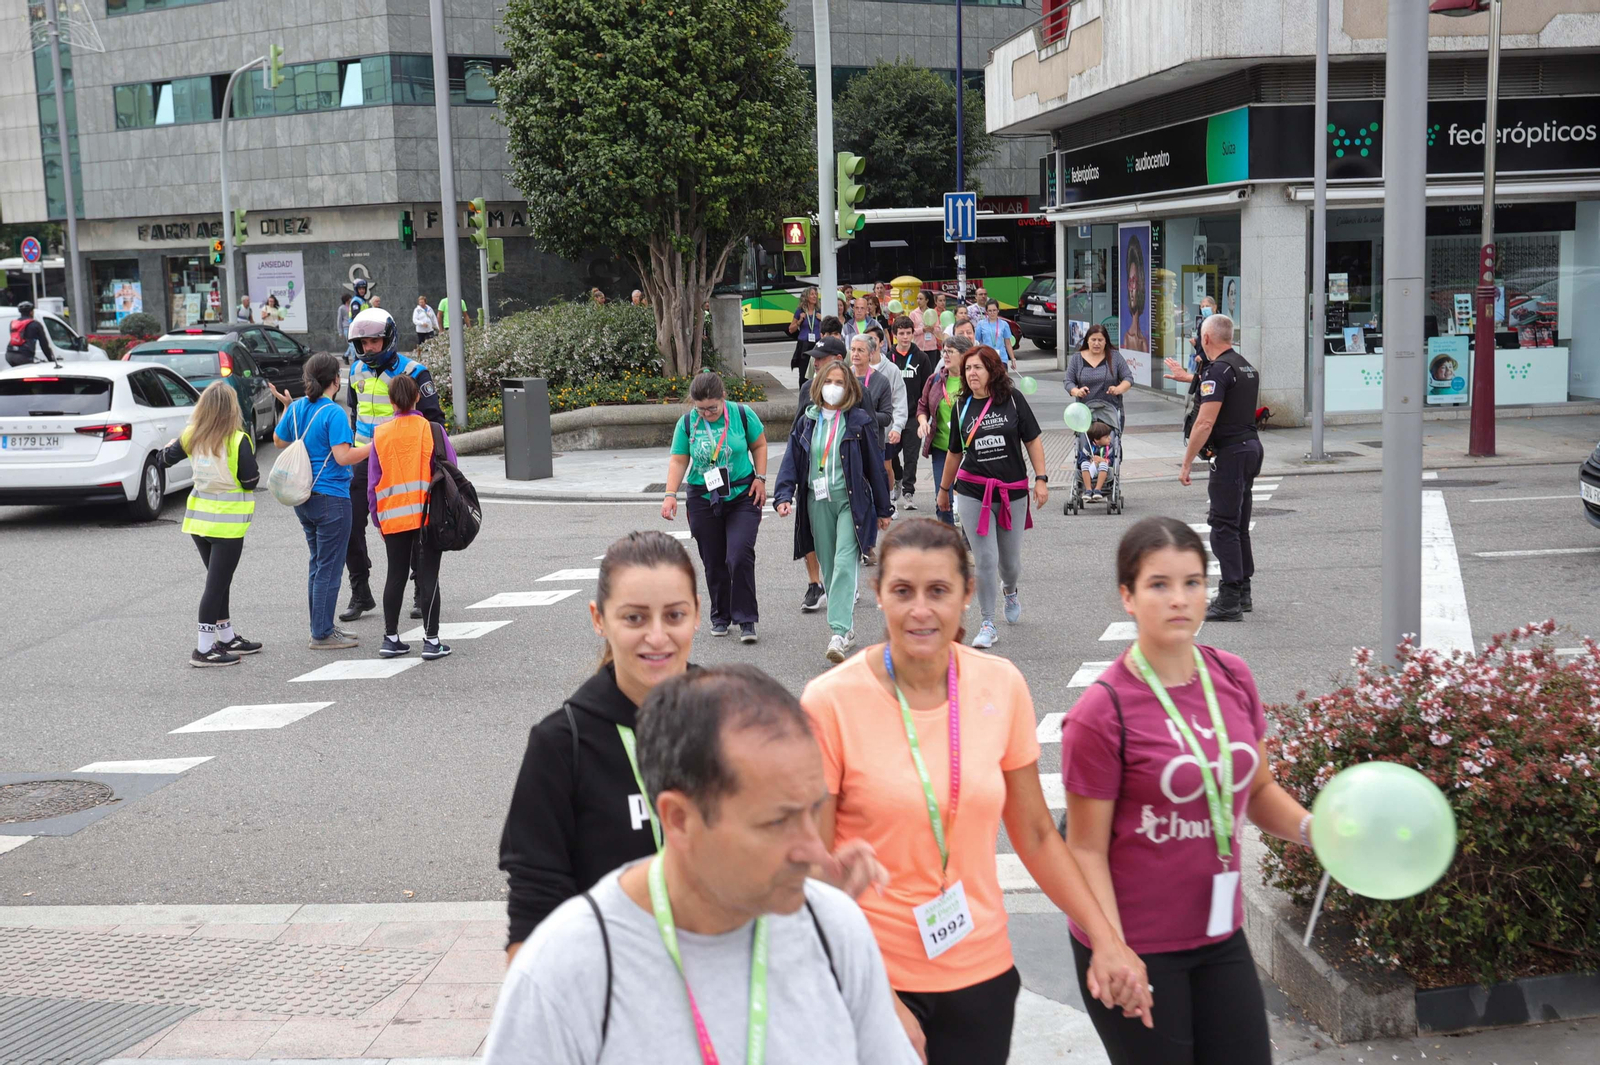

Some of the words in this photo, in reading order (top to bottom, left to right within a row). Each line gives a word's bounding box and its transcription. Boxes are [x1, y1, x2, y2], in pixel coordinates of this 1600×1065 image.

[1222, 141, 1236, 156] Suiza
[1135, 150, 1170, 172] audiocentro
[1071, 164, 1099, 184] federópticos
[138, 221, 249, 241] FARMACA
[260, 218, 309, 236] DIEZ
[215, 241, 222, 251] 6
[258, 260, 293, 270] ¿ANSIEDAD?
[979, 415, 1009, 426] ARBERÁ
[11, 437, 36, 447] 8179
[39, 436, 59, 446] LXH
[977, 437, 1004, 448] ARGAL
[929, 913, 966, 944] 1992
